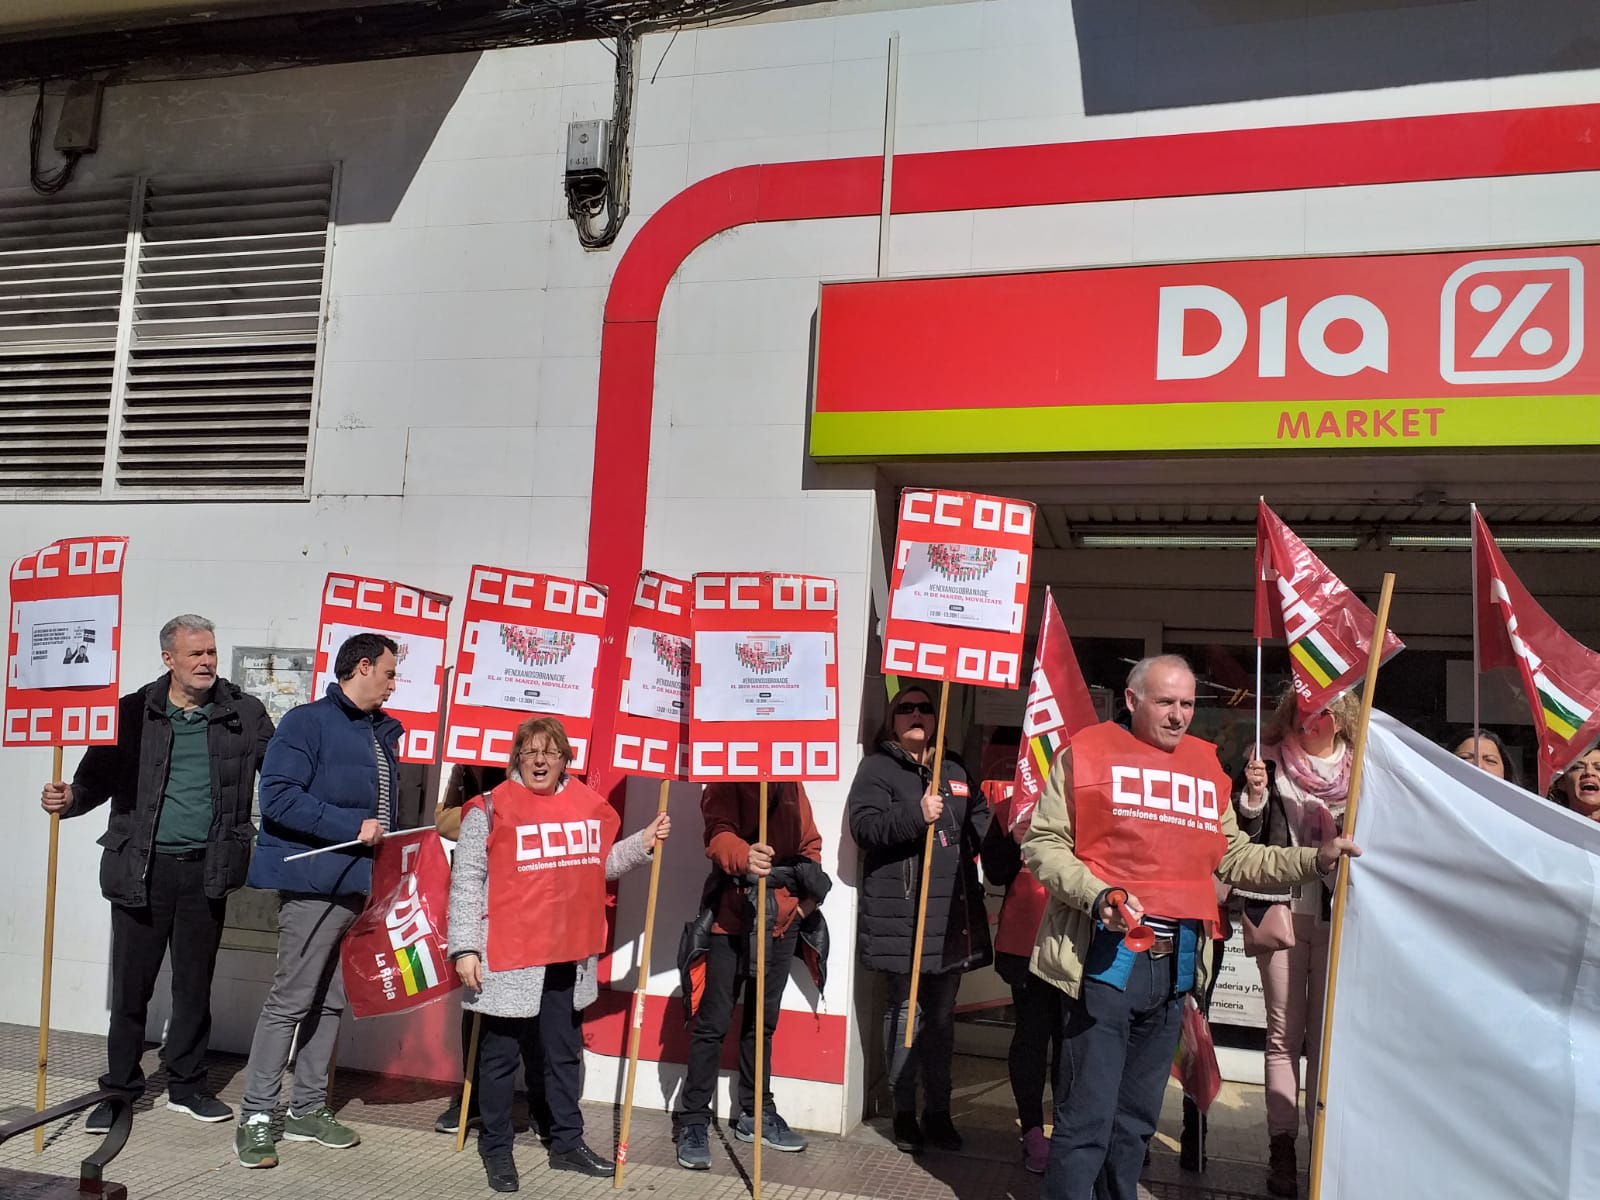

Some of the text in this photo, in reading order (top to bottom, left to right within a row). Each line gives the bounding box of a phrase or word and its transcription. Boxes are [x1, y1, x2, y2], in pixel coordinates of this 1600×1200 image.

[1276, 407, 1446, 439] MARKET
[1018, 757, 1038, 795] Rioja
[1111, 765, 1219, 821] CCOO
[1112, 807, 1219, 834] comisiones obreras de la Rioj
[516, 819, 602, 862] CCOO
[517, 861, 557, 872] comisiones
[557, 857, 581, 868] obreras
[374, 952, 396, 1001] La Rioja
[1244, 986, 1251, 994] y
